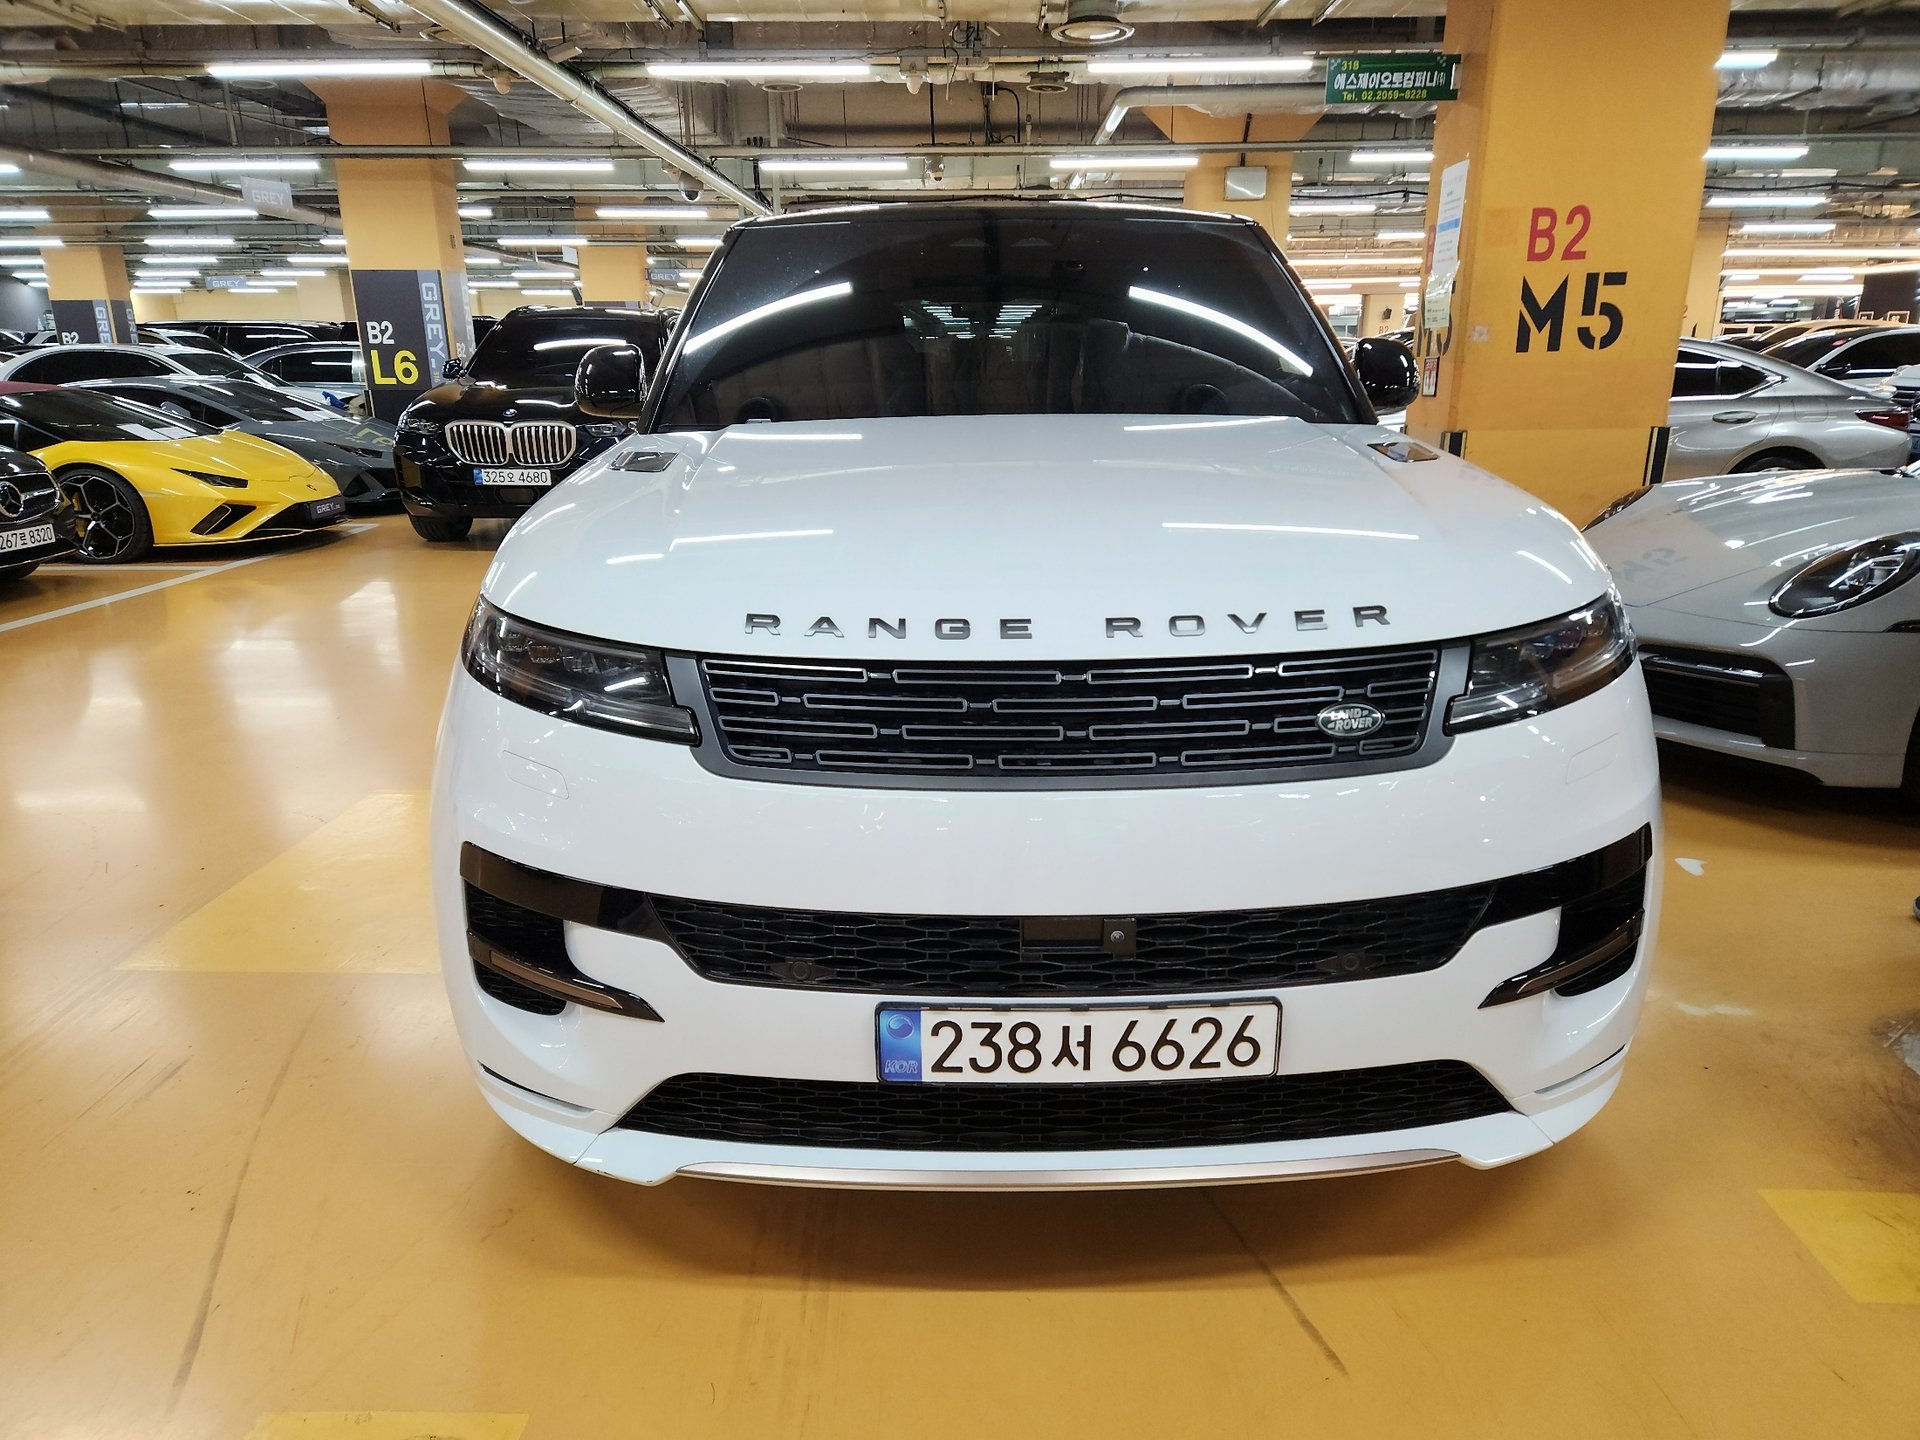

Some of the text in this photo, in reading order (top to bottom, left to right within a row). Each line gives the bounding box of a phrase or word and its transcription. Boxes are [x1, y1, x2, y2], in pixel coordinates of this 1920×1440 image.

[251, 190, 284, 206] GREY
[1527, 204, 1591, 262] B2
[212, 280, 240, 288] GREY
[1515, 271, 1628, 353] M5
[61, 331, 80, 344] B2
[366, 320, 395, 345] B2
[370, 349, 419, 385] L6
[483, 470, 548, 483] 325오 4680
[28, 526, 53, 544] 8320
[744, 604, 1391, 641] RANGE ROVER
[1330, 708, 1362, 720] LAND
[1335, 717, 1373, 731] ROVER
[930, 1014, 1262, 1074] 238서 6626
[884, 1059, 918, 1074] KOR
